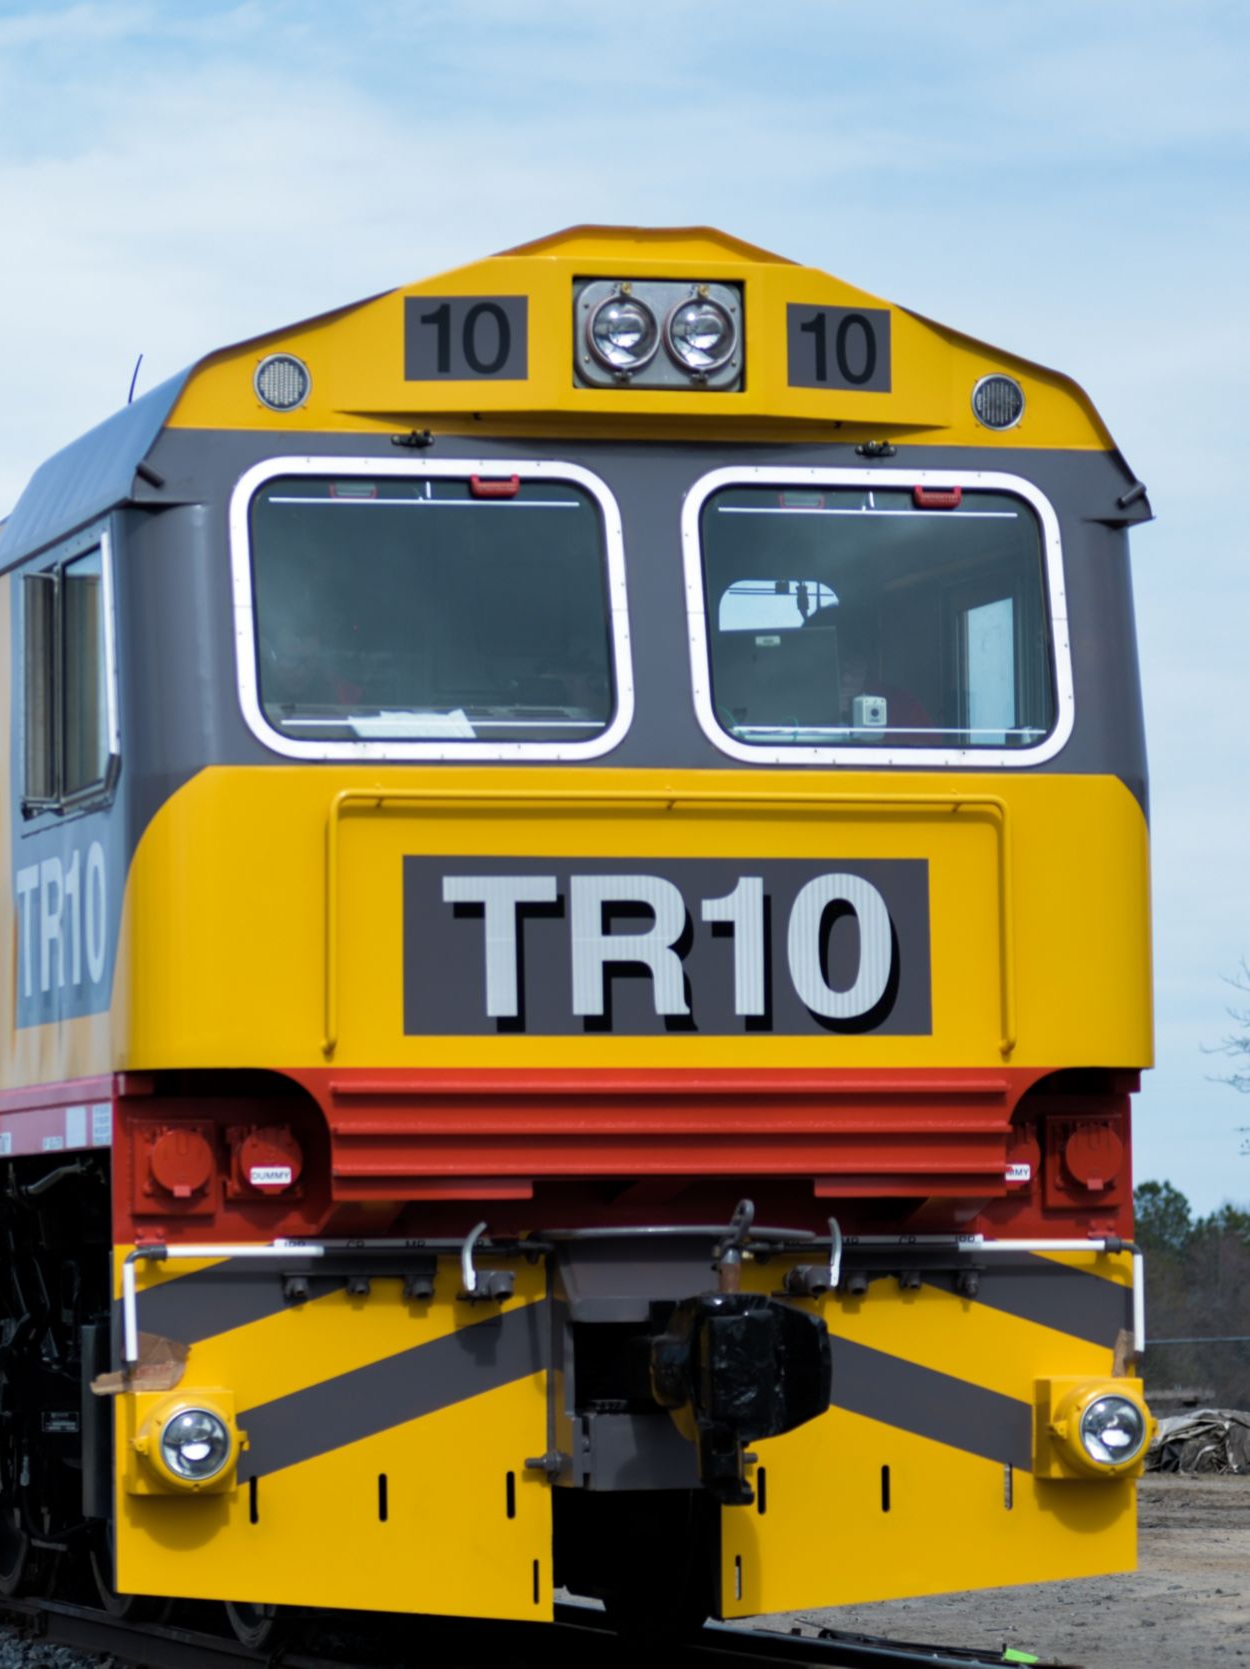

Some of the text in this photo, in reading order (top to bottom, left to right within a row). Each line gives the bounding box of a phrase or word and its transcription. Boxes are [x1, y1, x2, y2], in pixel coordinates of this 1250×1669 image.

[420, 302, 511, 374] 10
[800, 312, 877, 385] 10
[16, 841, 107, 998] TR10
[442, 873, 900, 1034] TR10
[252, 1171, 290, 1181] DUMMY
